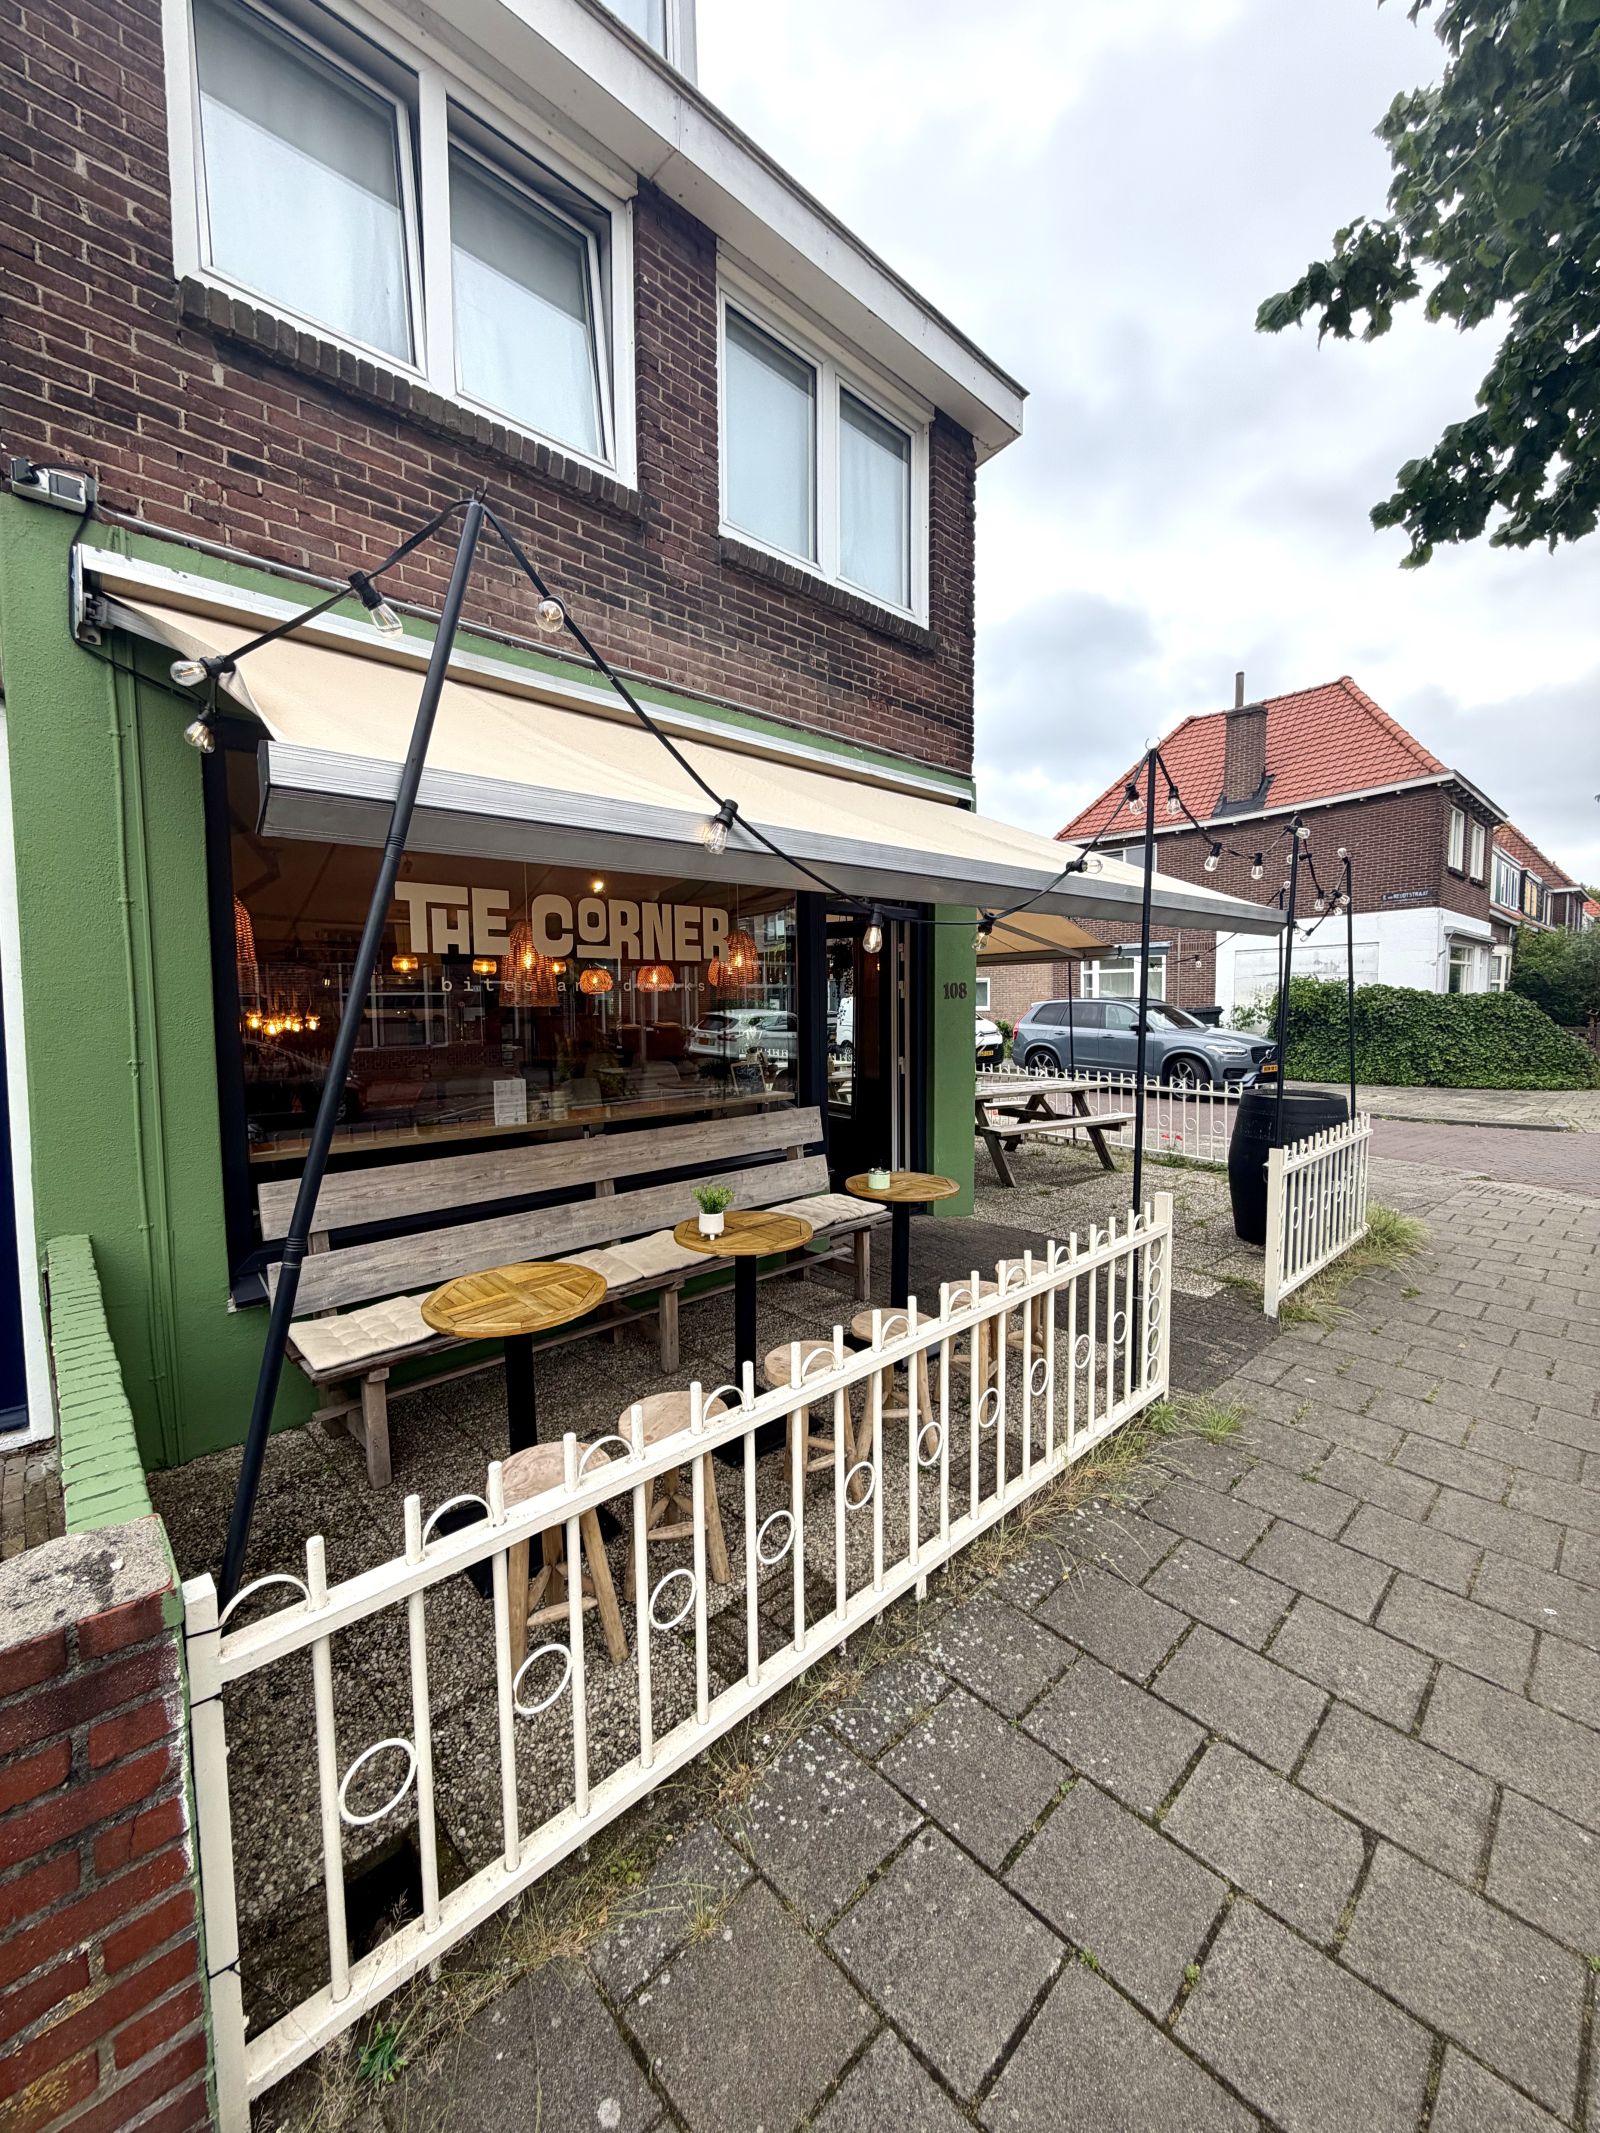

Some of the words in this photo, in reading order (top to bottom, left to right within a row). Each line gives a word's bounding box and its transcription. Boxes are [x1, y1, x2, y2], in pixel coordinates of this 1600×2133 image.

[394, 881, 510, 956] THE
[531, 893, 730, 962] CORNER
[441, 976, 533, 992] bites
[557, 978, 600, 992] an
[623, 978, 706, 992] dnks
[943, 982, 968, 1000] 108
